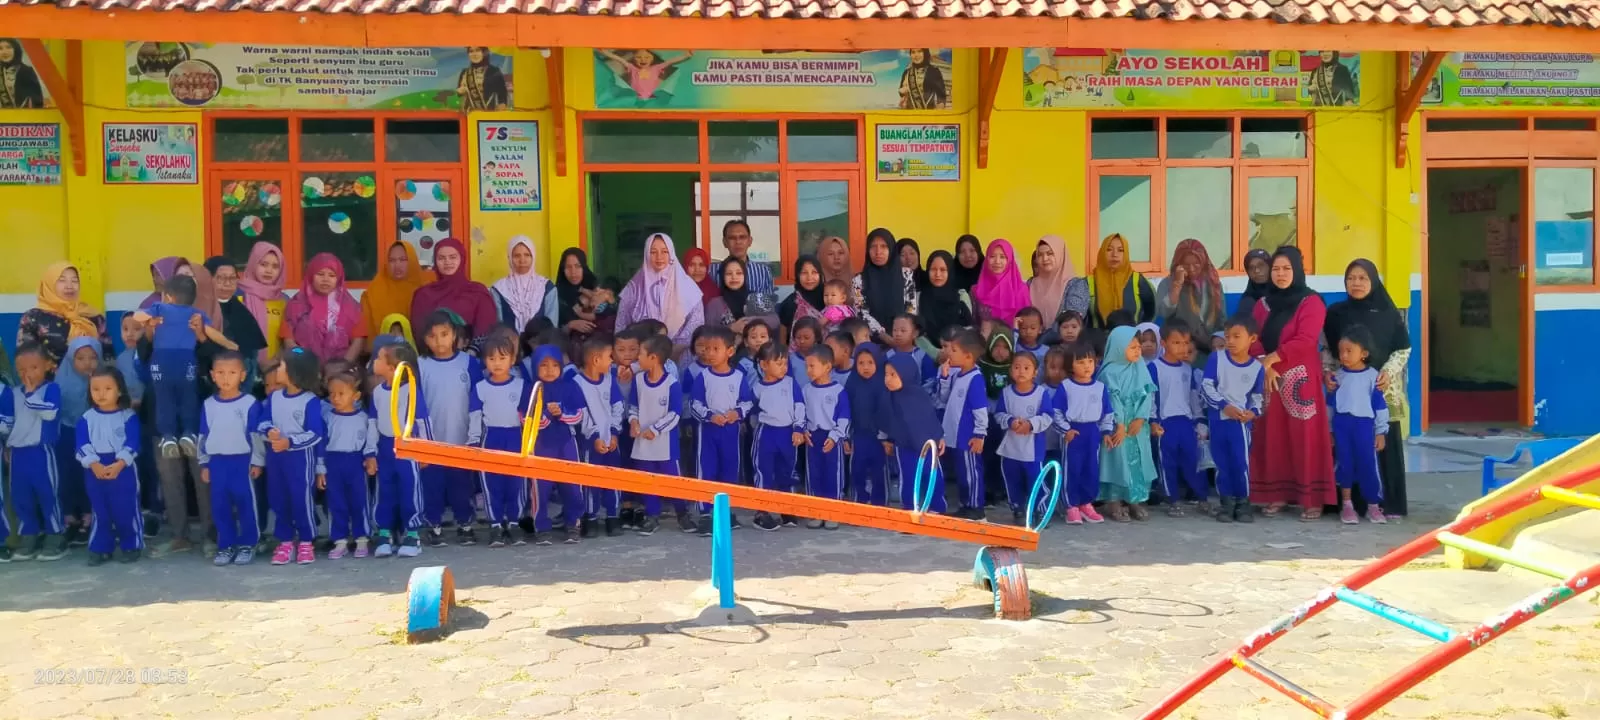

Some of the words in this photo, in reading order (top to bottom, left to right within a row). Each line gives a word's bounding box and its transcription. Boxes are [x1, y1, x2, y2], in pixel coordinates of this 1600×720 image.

[242, 46, 278, 54] Warna
[315, 48, 359, 56] nampak
[362, 48, 394, 56] indah
[396, 48, 430, 57] sekali
[313, 58, 356, 66] senyum
[709, 61, 733, 70] JIKA
[736, 61, 769, 70] KAMU
[772, 61, 798, 70] BISA
[801, 61, 859, 70] BERMIMPI
[1117, 56, 1158, 70] AYO
[1164, 56, 1260, 70] SEKOLAH
[258, 66, 287, 75] perlu
[413, 68, 437, 76] ilmu
[295, 77, 361, 86] Banyuanyar
[694, 74, 727, 83] KAMU
[731, 74, 762, 83] PASTI
[765, 74, 791, 83] BISA
[794, 74, 874, 84] MENCAPAINYA
[1125, 76, 1163, 86] MASA
[1166, 76, 1211, 86] DEPAN
[1215, 77, 1250, 86] YANG
[338, 88, 377, 96] belajar
[108, 128, 158, 142] KELASKU
[485, 127, 508, 141] 7S
[880, 129, 923, 140] BUANGLAH
[925, 129, 956, 140] SAMPAH
[882, 144, 908, 152] SESUAI
[911, 144, 954, 152] TEMPATNYA
[145, 155, 191, 168] SEKOLAHKU
[156, 168, 192, 180] Istanaku
